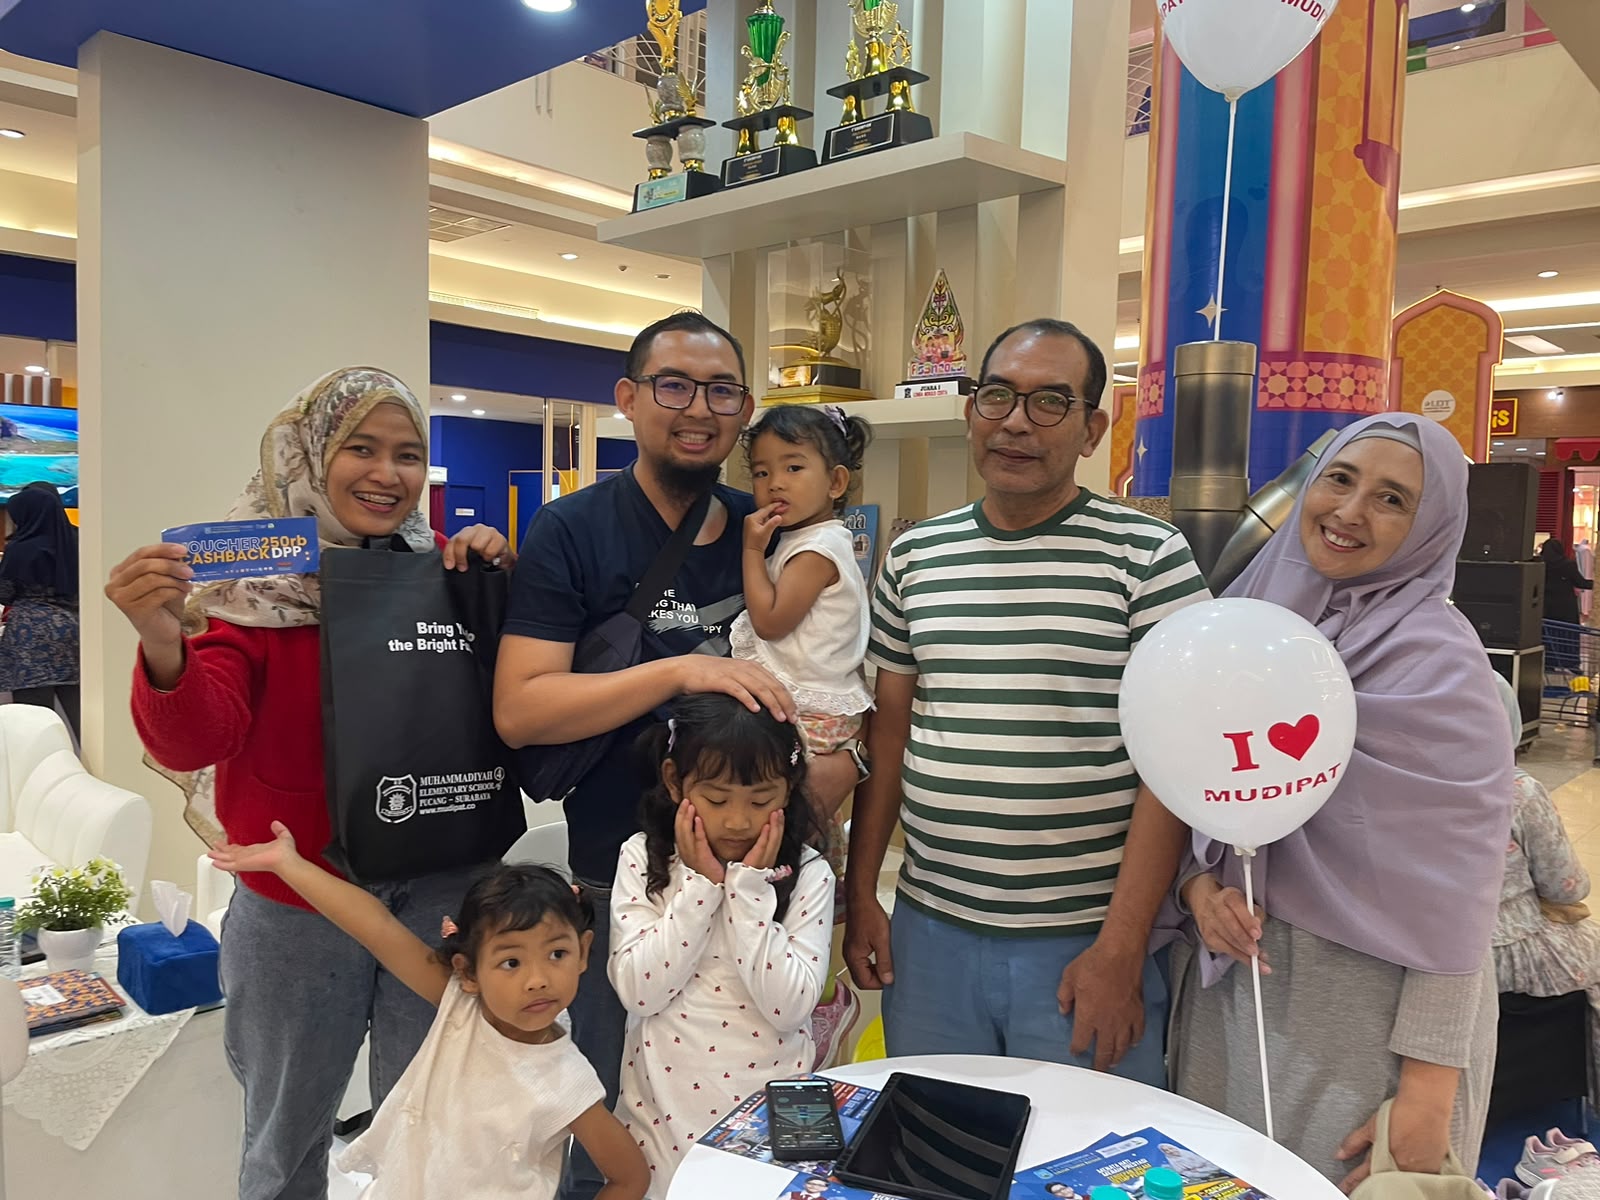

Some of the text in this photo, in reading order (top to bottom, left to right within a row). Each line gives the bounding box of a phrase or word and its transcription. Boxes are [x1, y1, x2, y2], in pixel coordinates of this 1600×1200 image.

[183, 534, 307, 554] OUCHER 250rb
[271, 545, 302, 559] DPP
[647, 609, 699, 624] KES YOU
[416, 622, 454, 637] Bring
[388, 639, 414, 652] the
[416, 638, 457, 653] Bright
[1222, 730, 1260, 772] I
[420, 771, 493, 786] MUHAMMADIYAH
[1204, 762, 1341, 802] MUDIPAT
[419, 782, 495, 797] ELEMENTARY SCHOOL
[419, 797, 447, 807] PUCANG
[454, 793, 491, 803] SURABAYA
